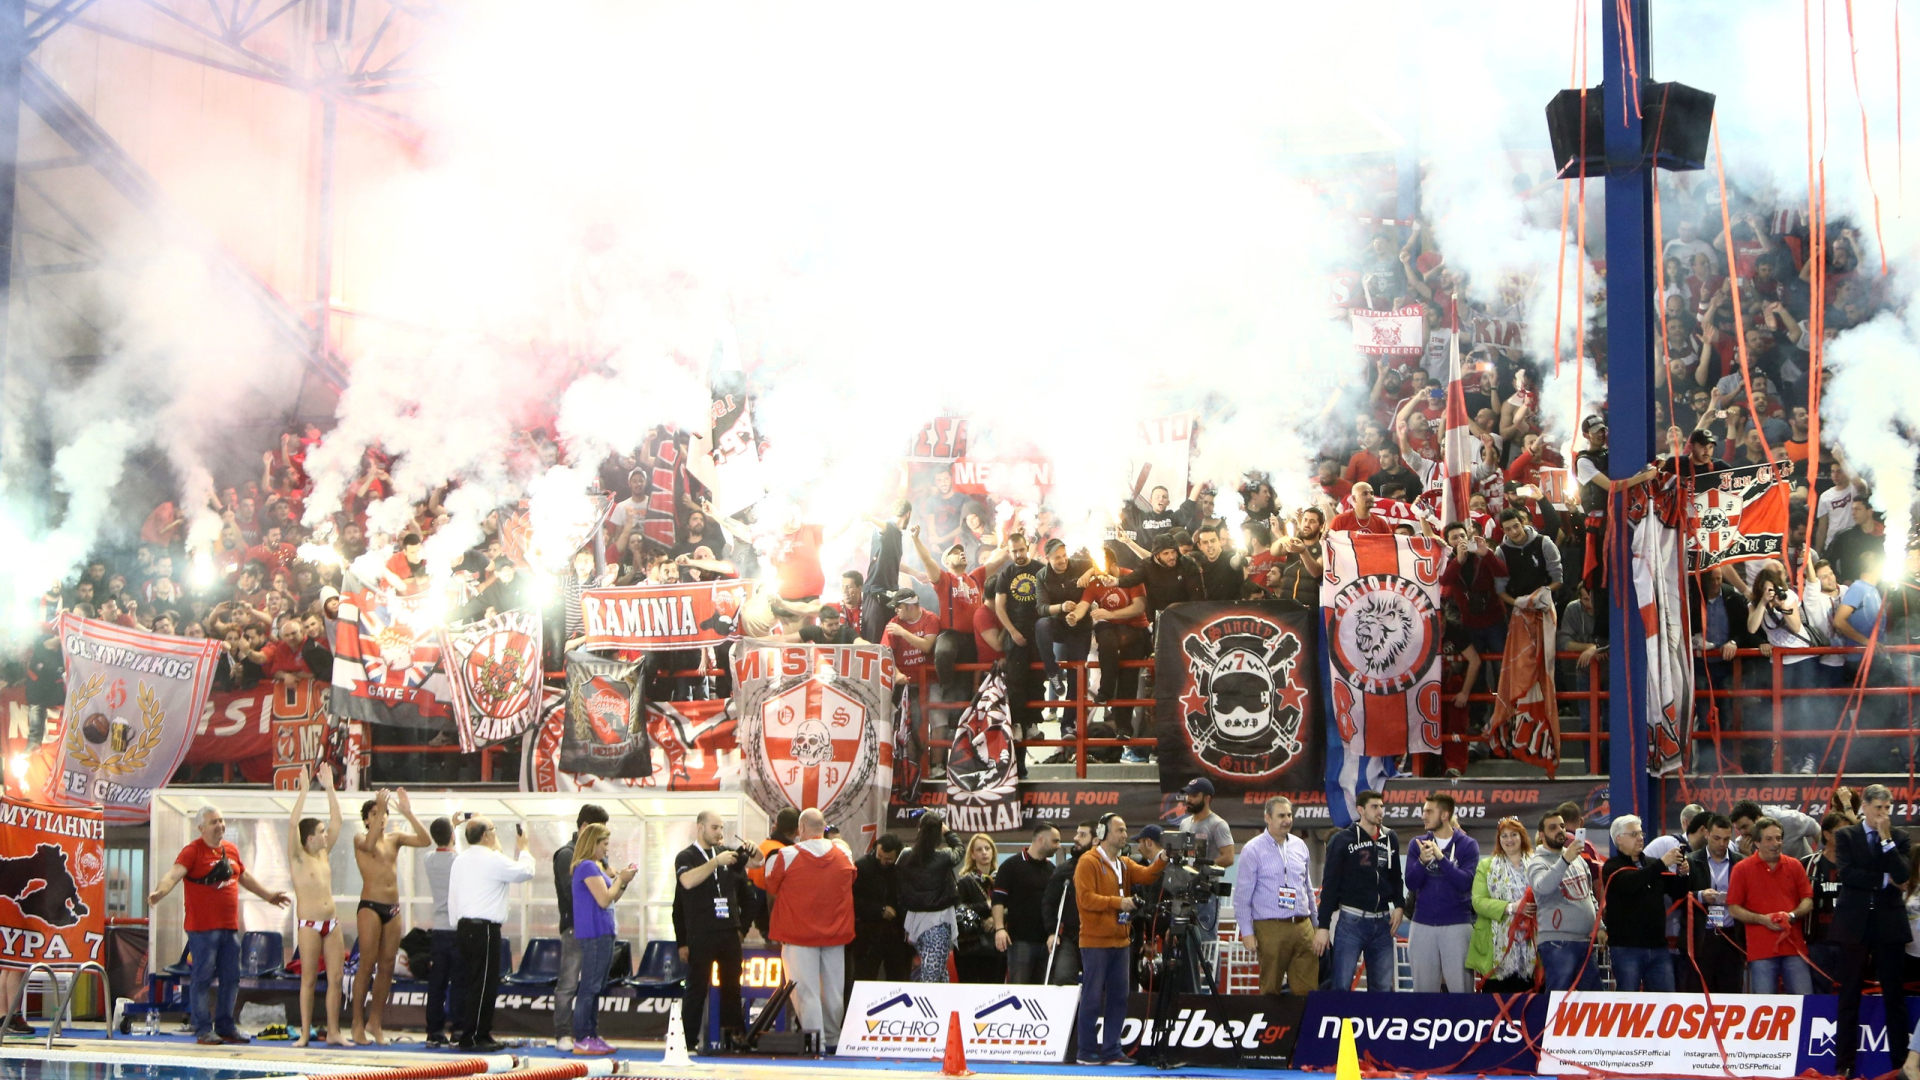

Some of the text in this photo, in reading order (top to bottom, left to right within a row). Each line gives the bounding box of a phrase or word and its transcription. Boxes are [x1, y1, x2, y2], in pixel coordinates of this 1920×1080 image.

[1233, 654, 1245, 670] 7
[367, 685, 418, 700] GATE 7
[1219, 756, 1257, 774] Gate
[1023, 792, 1071, 805] FINAL
[1075, 792, 1120, 805] FOUR
[1382, 789, 1430, 804] OMEN
[1491, 789, 1540, 804] FOUR
[1675, 787, 1798, 802] EUROLEAGUE
[1033, 807, 1070, 819] 2015
[865, 1019, 940, 1037] VECHRO
[1552, 1001, 1797, 1041] WWW.OSFP.GR
[973, 1022, 1050, 1039] VECHRO
